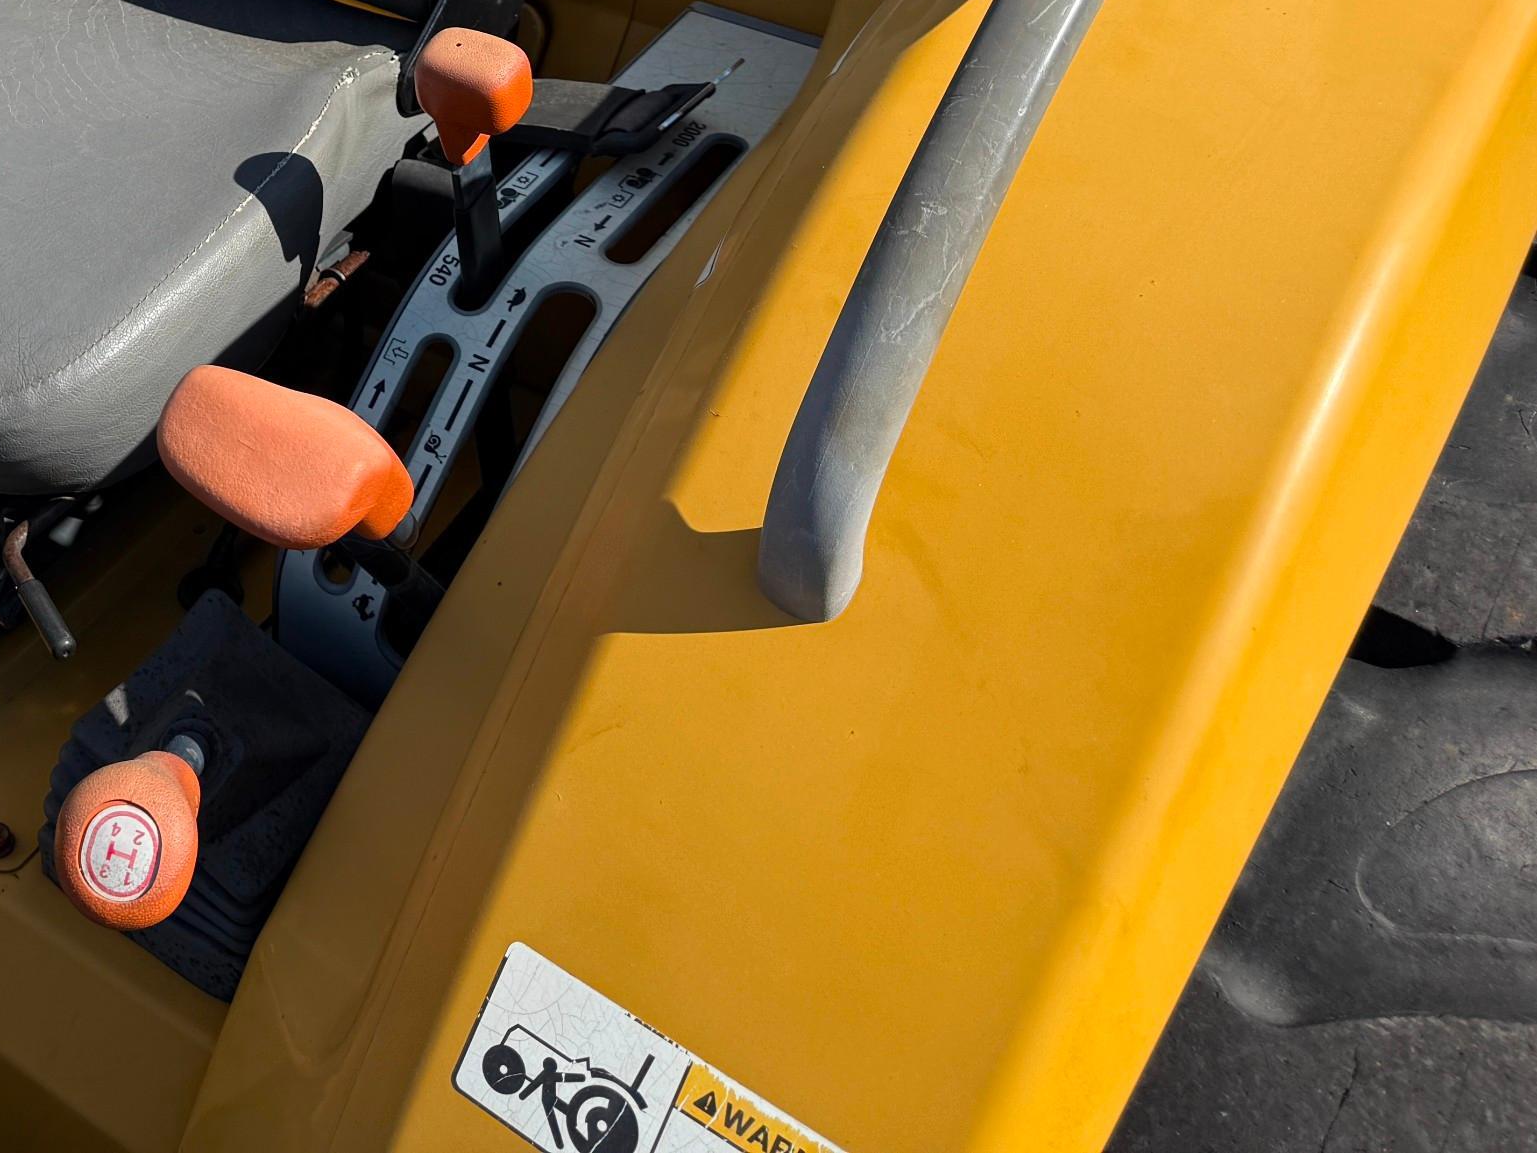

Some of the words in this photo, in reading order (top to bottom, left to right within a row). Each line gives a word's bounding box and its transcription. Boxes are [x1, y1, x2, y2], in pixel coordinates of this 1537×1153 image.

[671, 120, 706, 147] 2000
[575, 233, 596, 248] N
[429, 254, 460, 286] 540
[467, 354, 492, 372] N
[133, 830, 145, 845] 2
[724, 1102, 807, 1153] WAR
